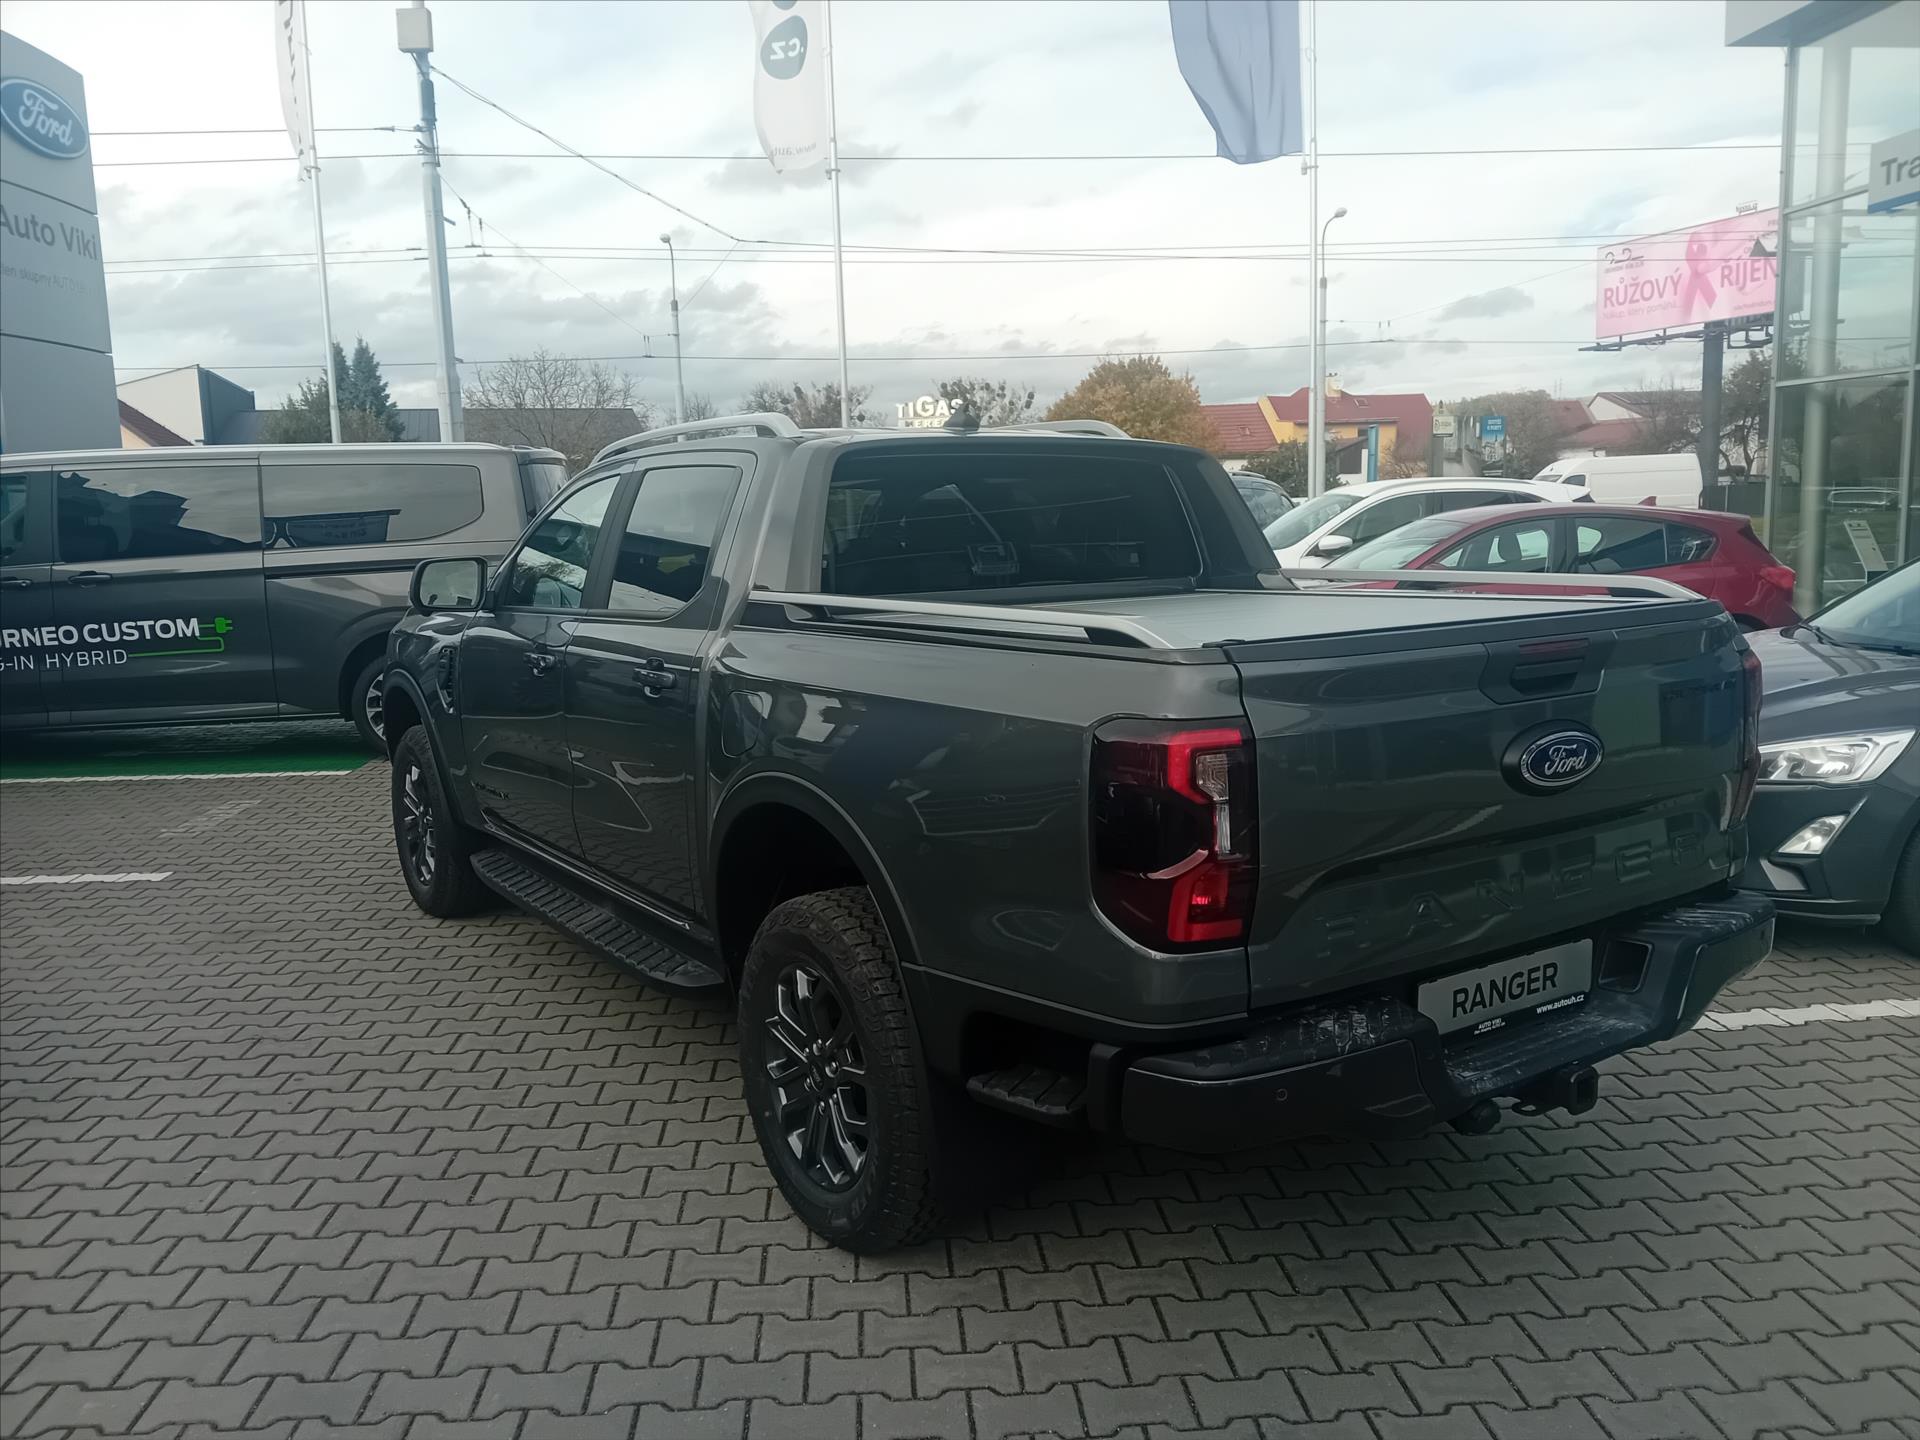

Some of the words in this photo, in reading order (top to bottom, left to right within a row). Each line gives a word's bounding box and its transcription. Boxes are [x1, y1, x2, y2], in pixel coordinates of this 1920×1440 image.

[18, 88, 74, 147] Ford
[1880, 154, 1920, 187] Tra
[0, 203, 56, 247] Auto
[59, 222, 98, 261] Viki
[1603, 267, 1682, 309] RŮŽOVÝ
[0, 625, 79, 649] RNEO
[83, 617, 200, 643] CUSTOM
[46, 649, 128, 669] HYBRID
[1544, 743, 1588, 776] Ford
[1452, 962, 1559, 1018] RANGER
[1536, 994, 1585, 1015] www.autouh.cz
[1478, 1020, 1492, 1029] AUTO
